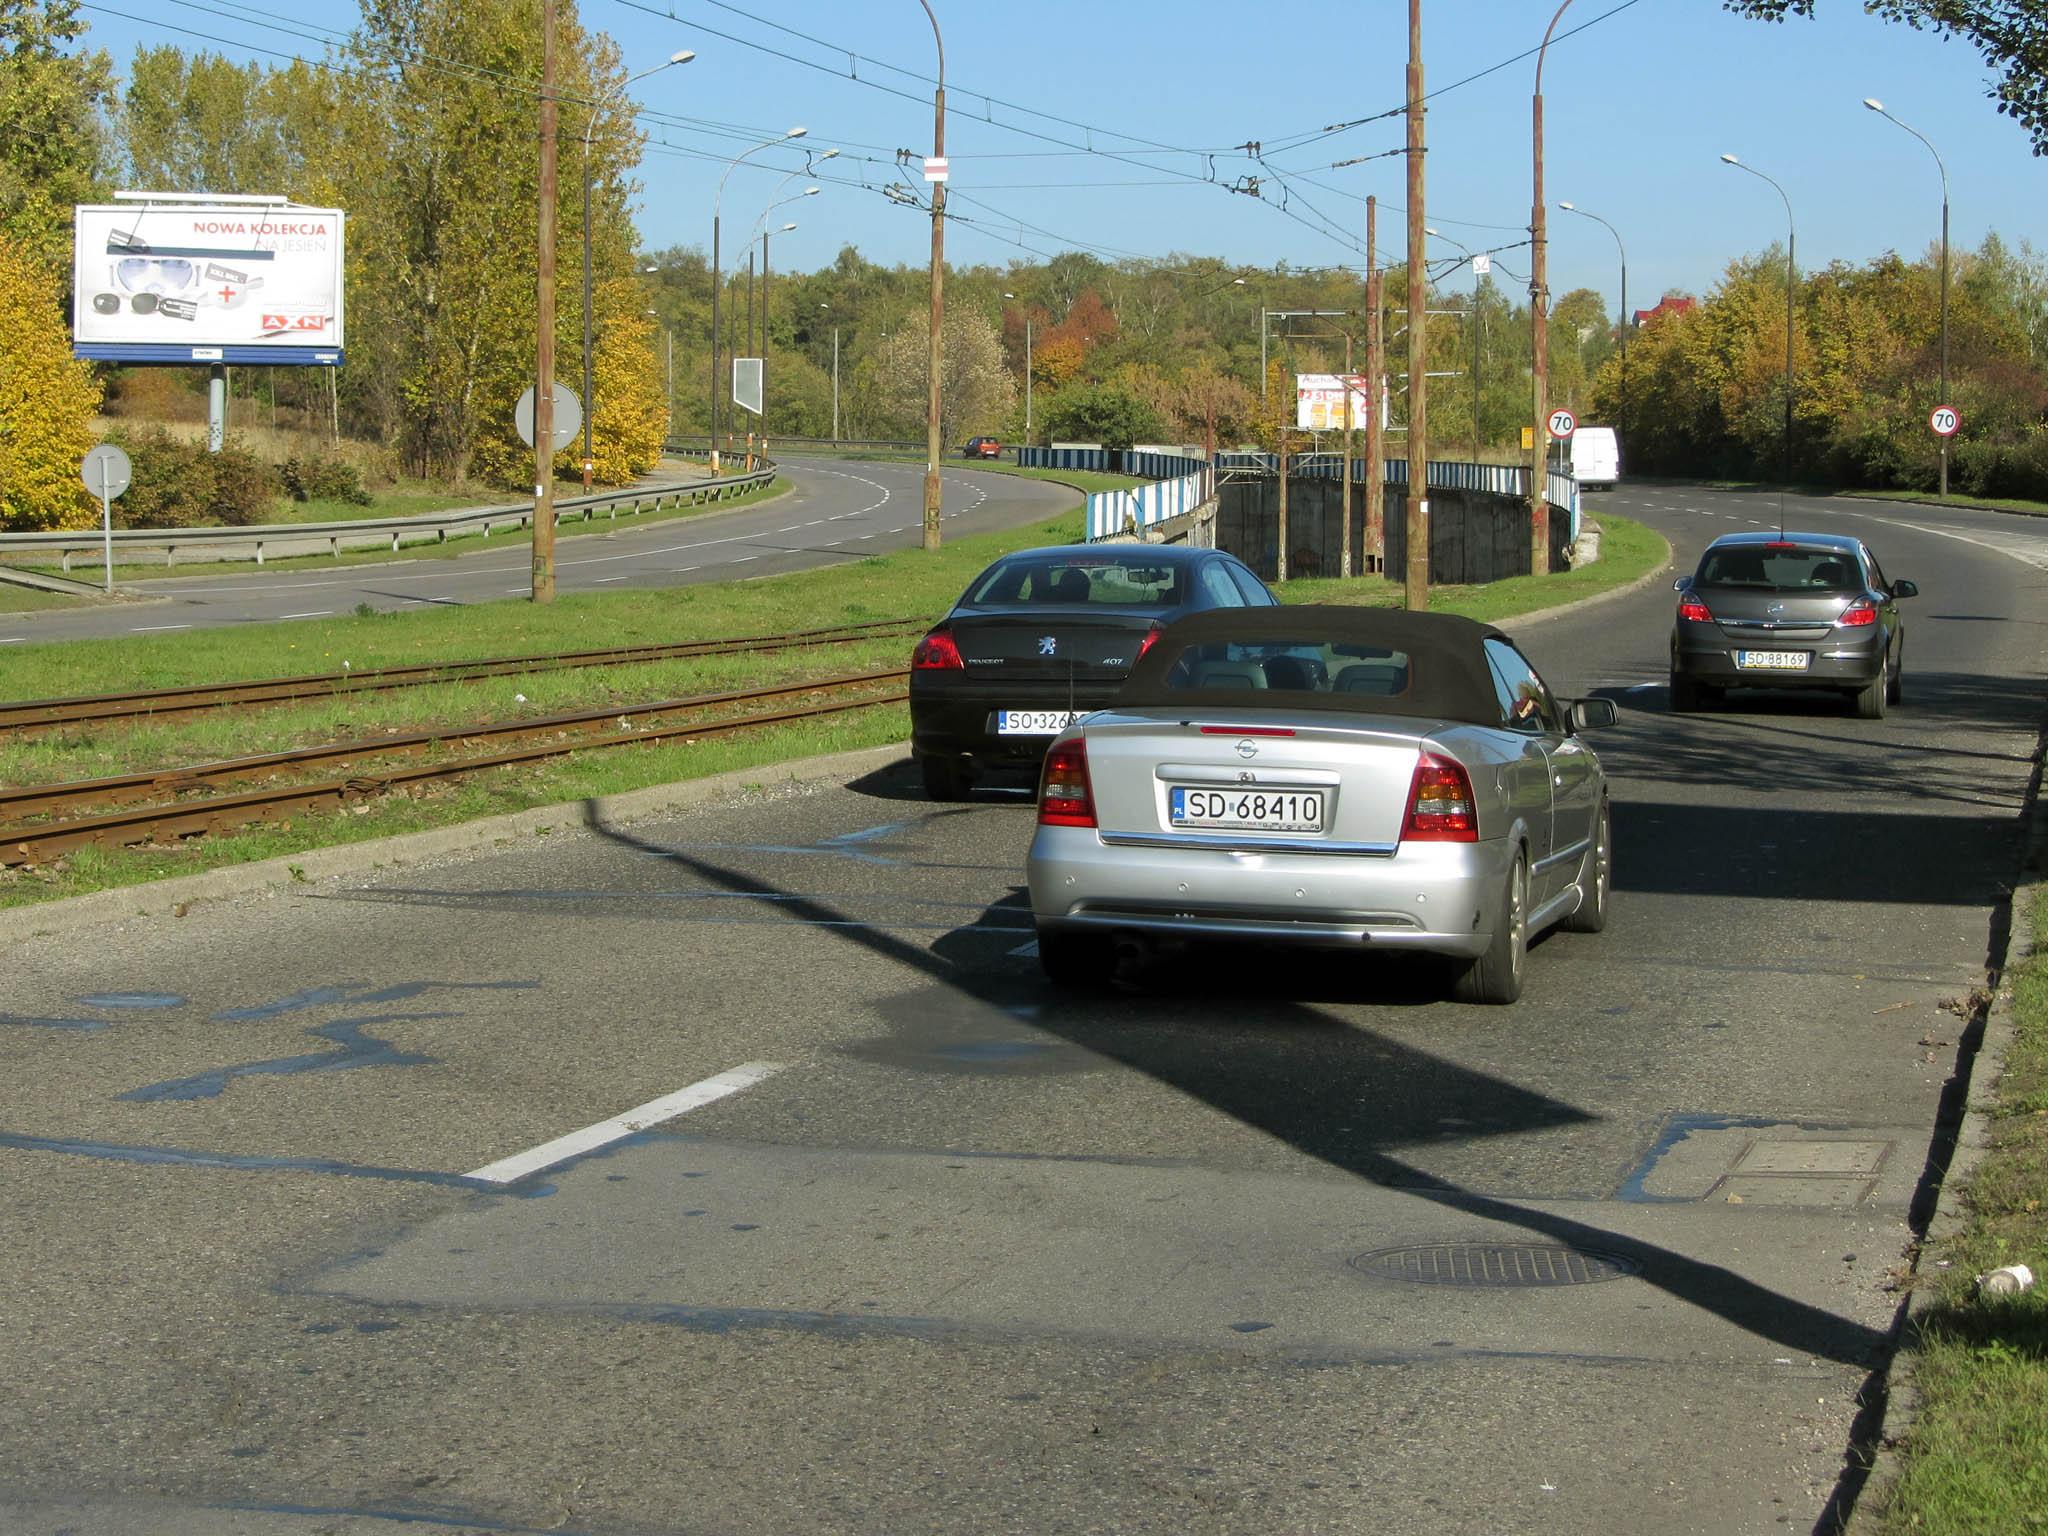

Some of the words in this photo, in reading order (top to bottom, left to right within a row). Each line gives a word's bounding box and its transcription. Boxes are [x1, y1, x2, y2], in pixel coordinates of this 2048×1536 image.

[194, 222, 245, 234] NOWA
[250, 223, 327, 235] KOLEKCJA
[257, 239, 279, 251] NA
[263, 315, 321, 330] AXN
[1554, 416, 1572, 431] 70
[1936, 414, 1954, 428] 70
[1747, 652, 1764, 665] SD
[1768, 653, 1804, 666] 88169
[1174, 807, 1184, 815] PL
[1190, 793, 1226, 818] SD
[1236, 795, 1317, 821] 68410
